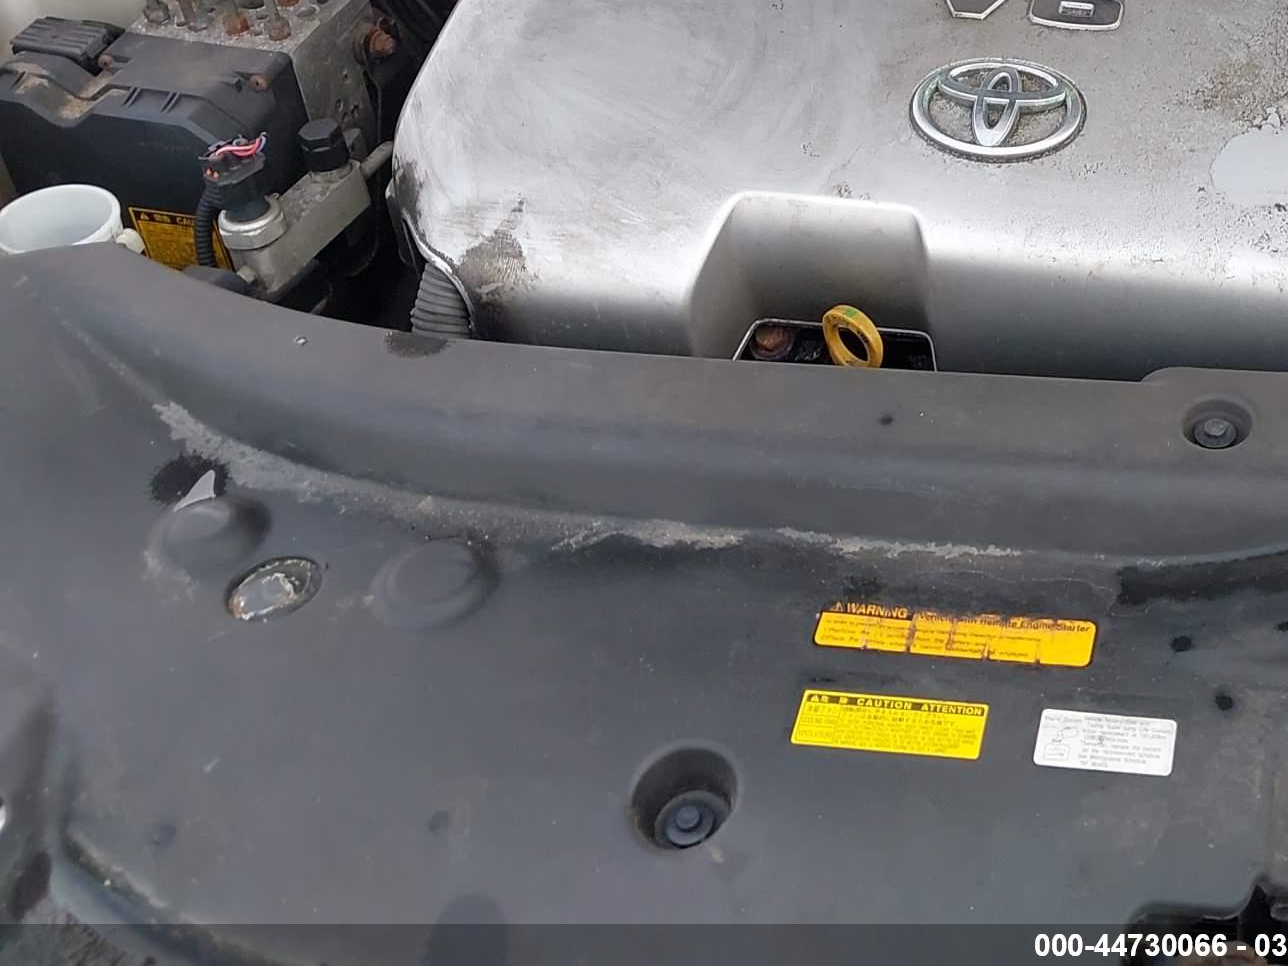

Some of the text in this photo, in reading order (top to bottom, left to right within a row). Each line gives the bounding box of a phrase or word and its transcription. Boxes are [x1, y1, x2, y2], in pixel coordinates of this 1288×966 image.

[846, 602, 909, 619] WARNING
[1056, 622, 1091, 633] Starter
[856, 697, 912, 710] CAUTION
[920, 703, 982, 715] ATTENTION
